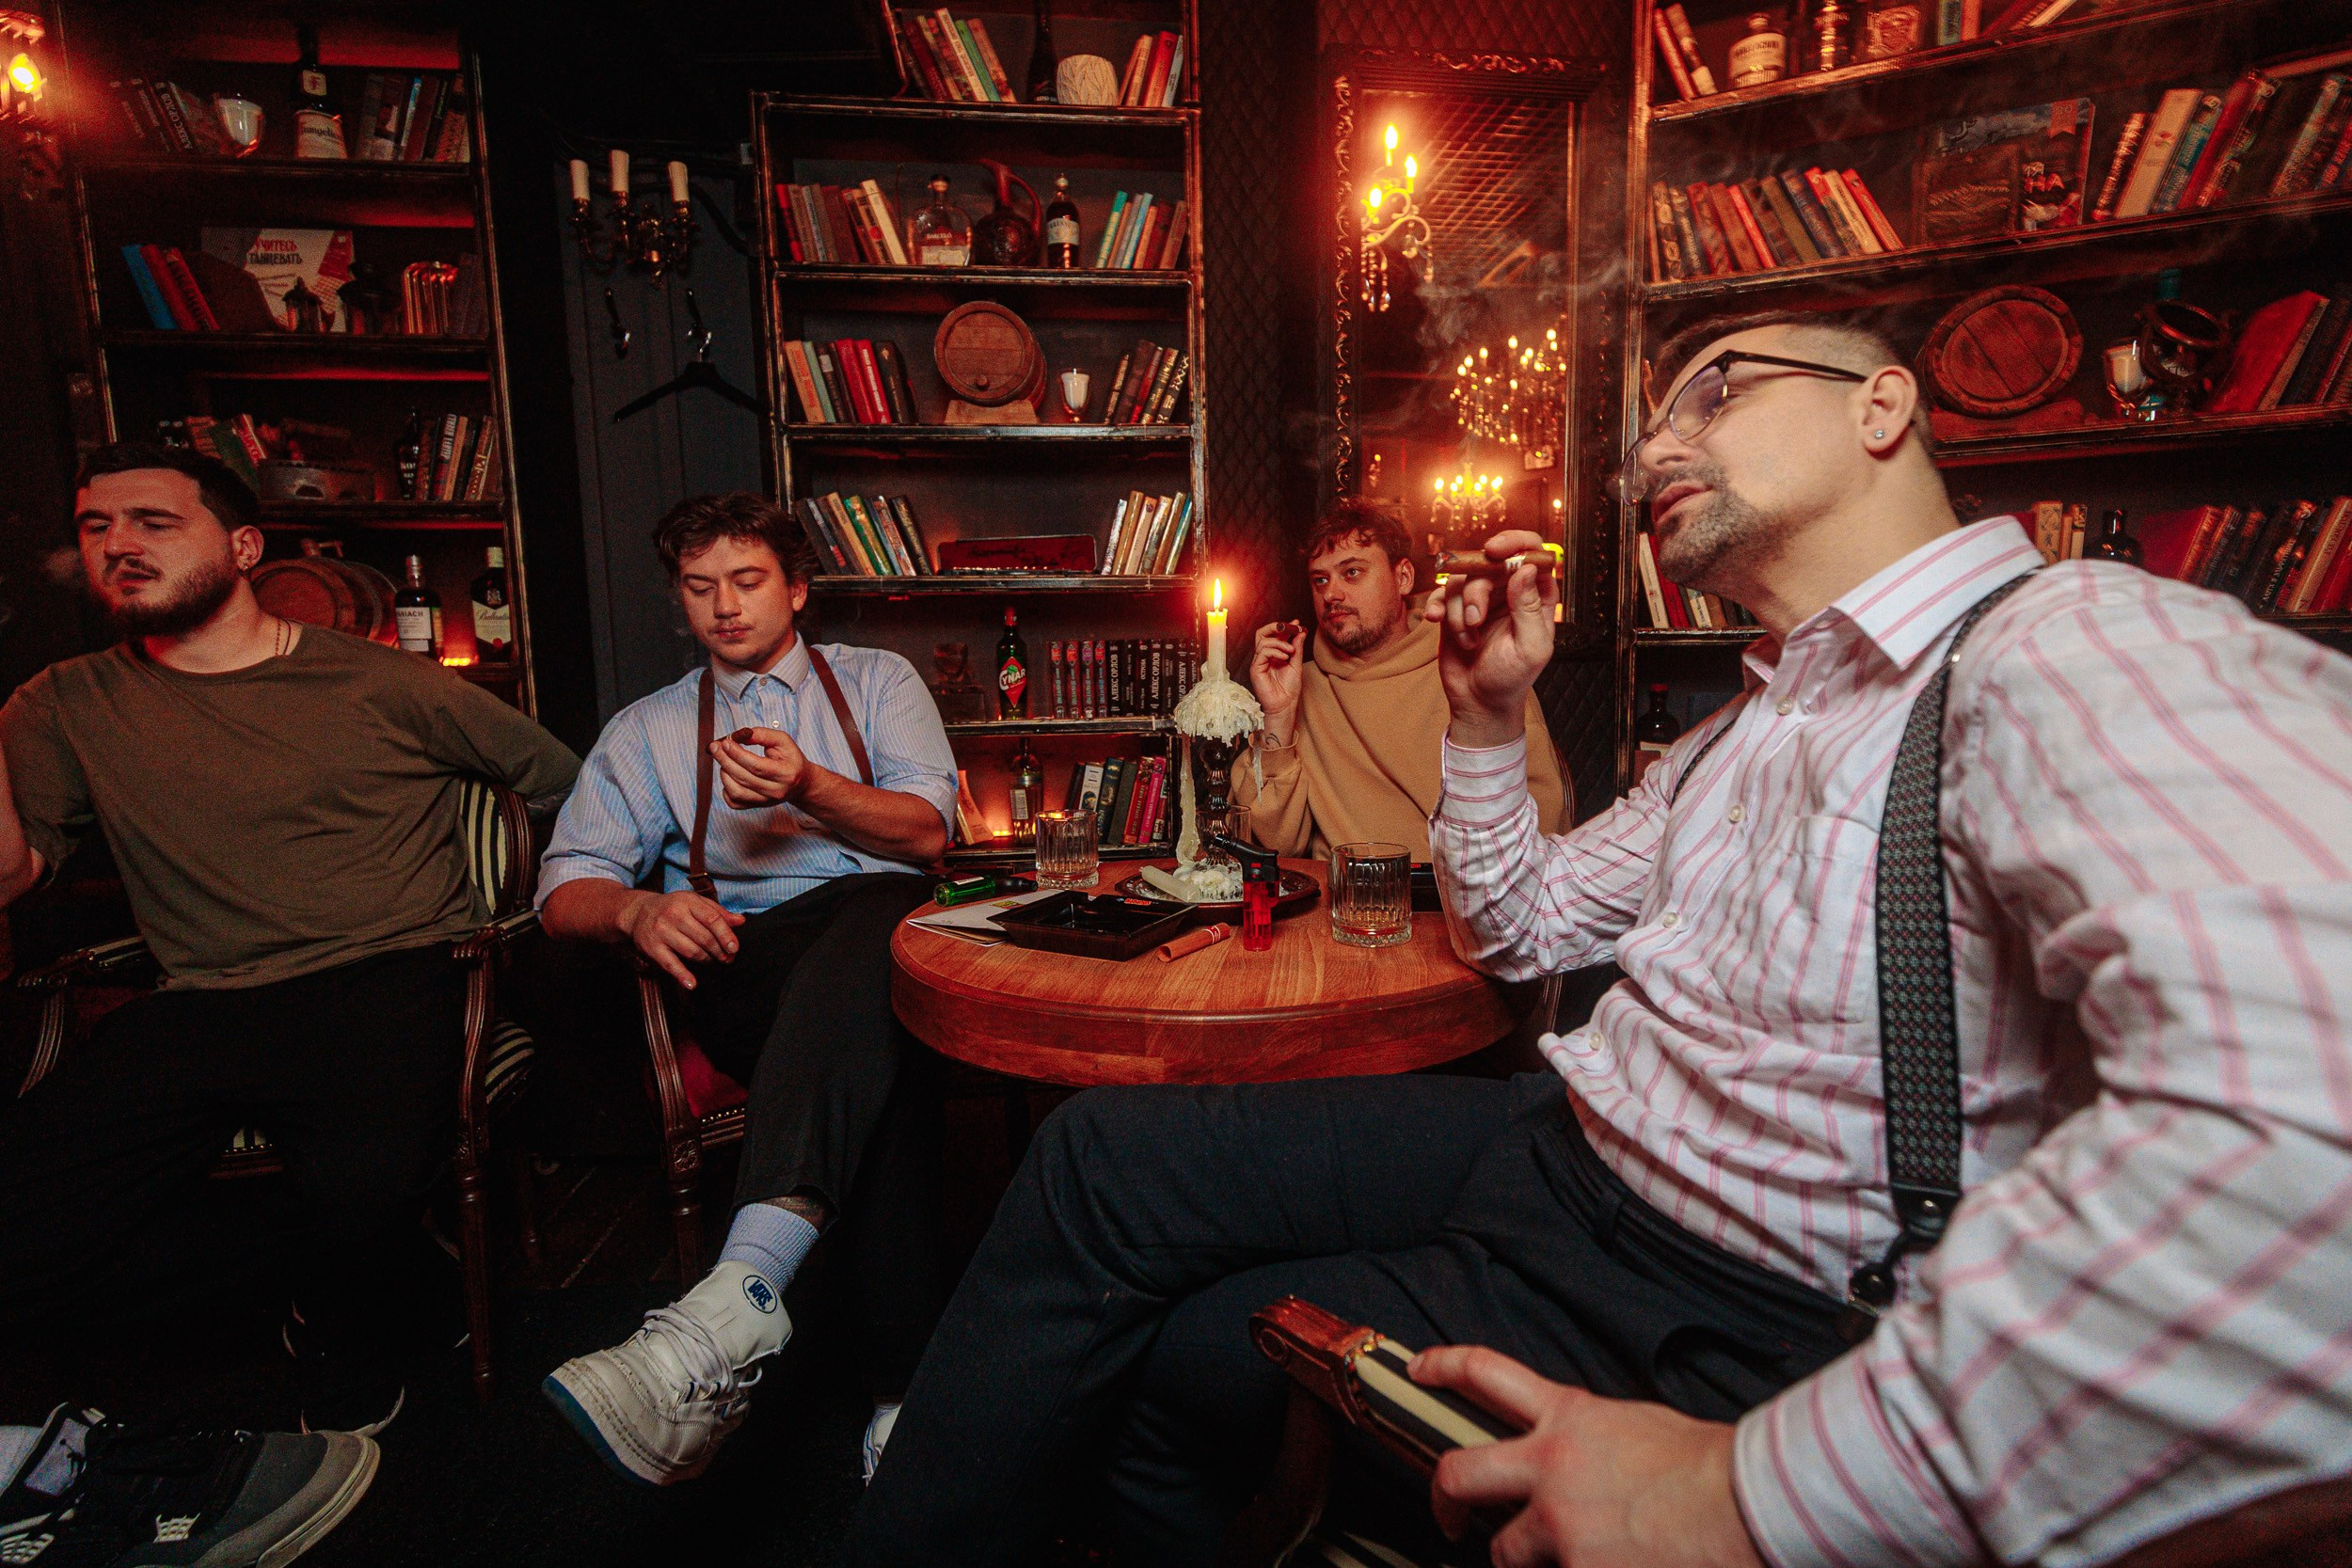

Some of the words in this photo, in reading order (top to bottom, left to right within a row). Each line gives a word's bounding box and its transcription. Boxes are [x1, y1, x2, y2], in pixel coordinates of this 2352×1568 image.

[254, 238, 298, 252] УЧИТЕСЬ
[249, 252, 303, 265] ТАНЦЕВАТЬ
[1110, 654, 1119, 677] ОРЛОВ
[998, 668, 1026, 691] CYNAR
[1111, 678, 1120, 702] АЛЕКС
[1152, 676, 1160, 700] АЛЕКС
